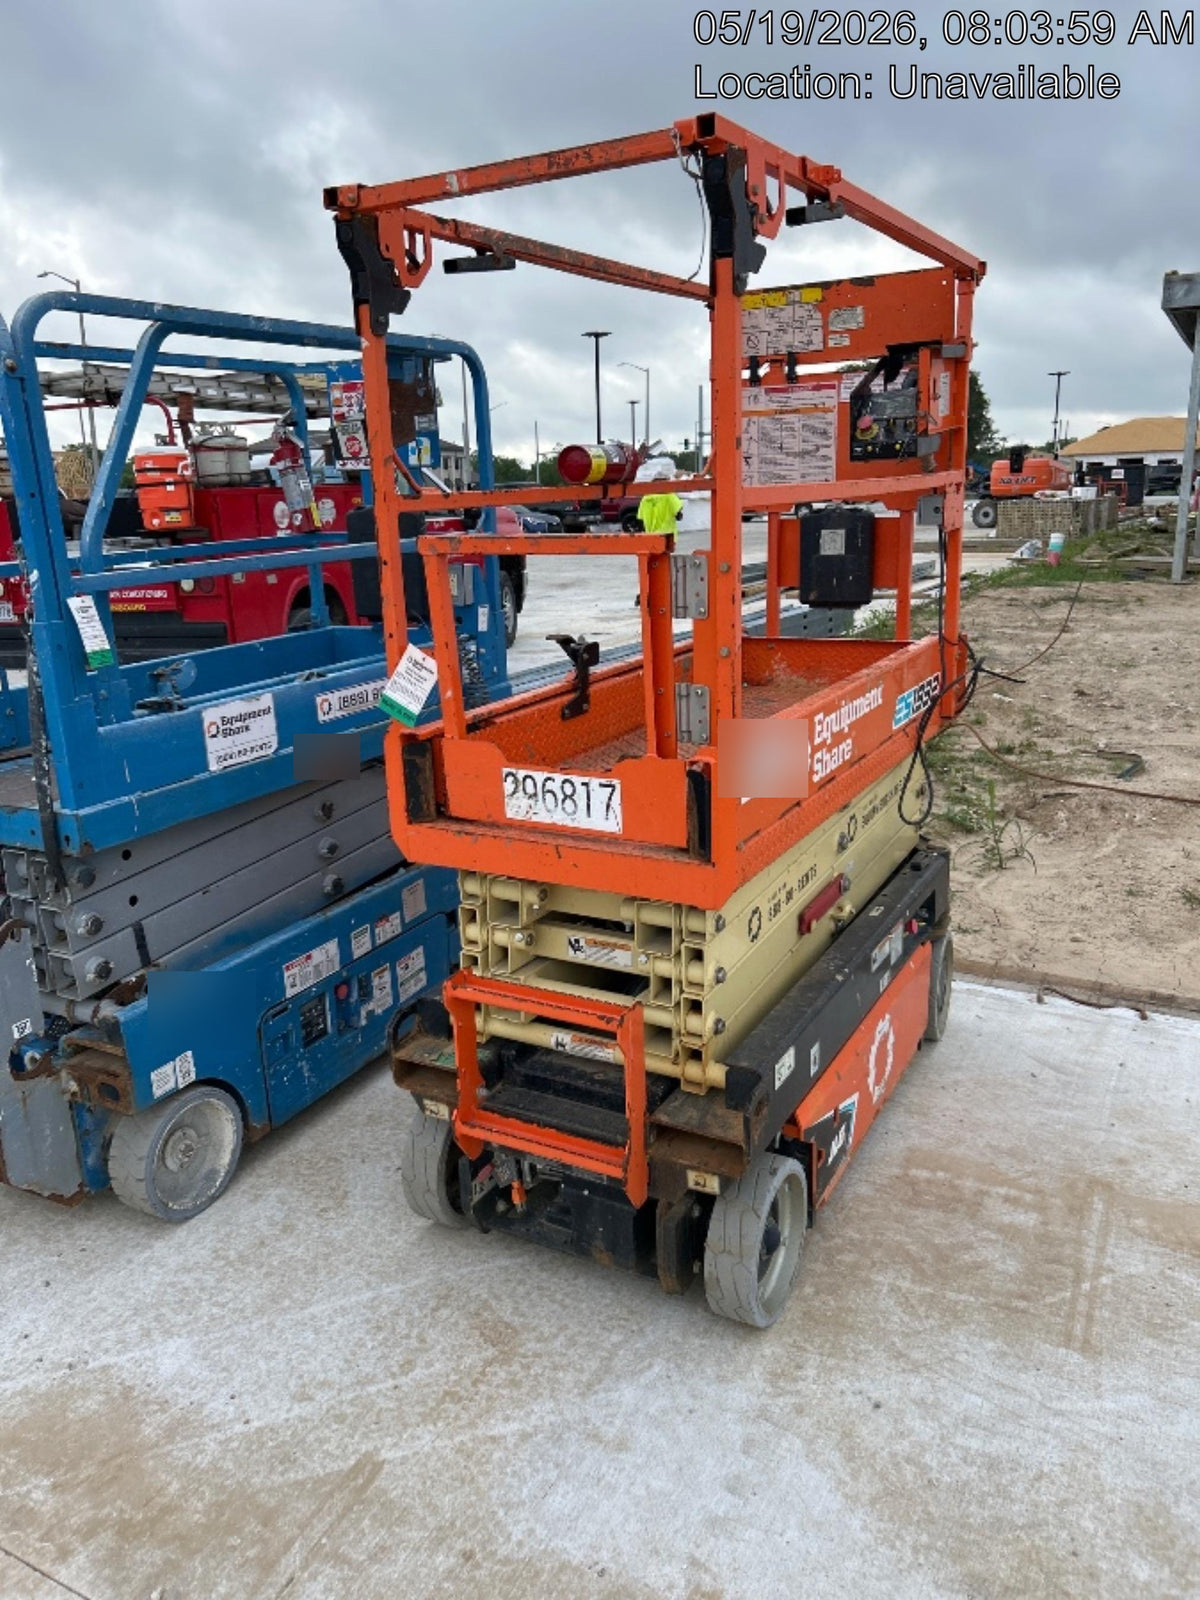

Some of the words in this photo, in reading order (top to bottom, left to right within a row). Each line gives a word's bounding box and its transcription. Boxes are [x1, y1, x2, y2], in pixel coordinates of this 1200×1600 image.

[220, 705, 272, 727] Equipment
[814, 683, 884, 745] Equipment
[221, 725, 251, 738] Share
[812, 739, 853, 783] Share
